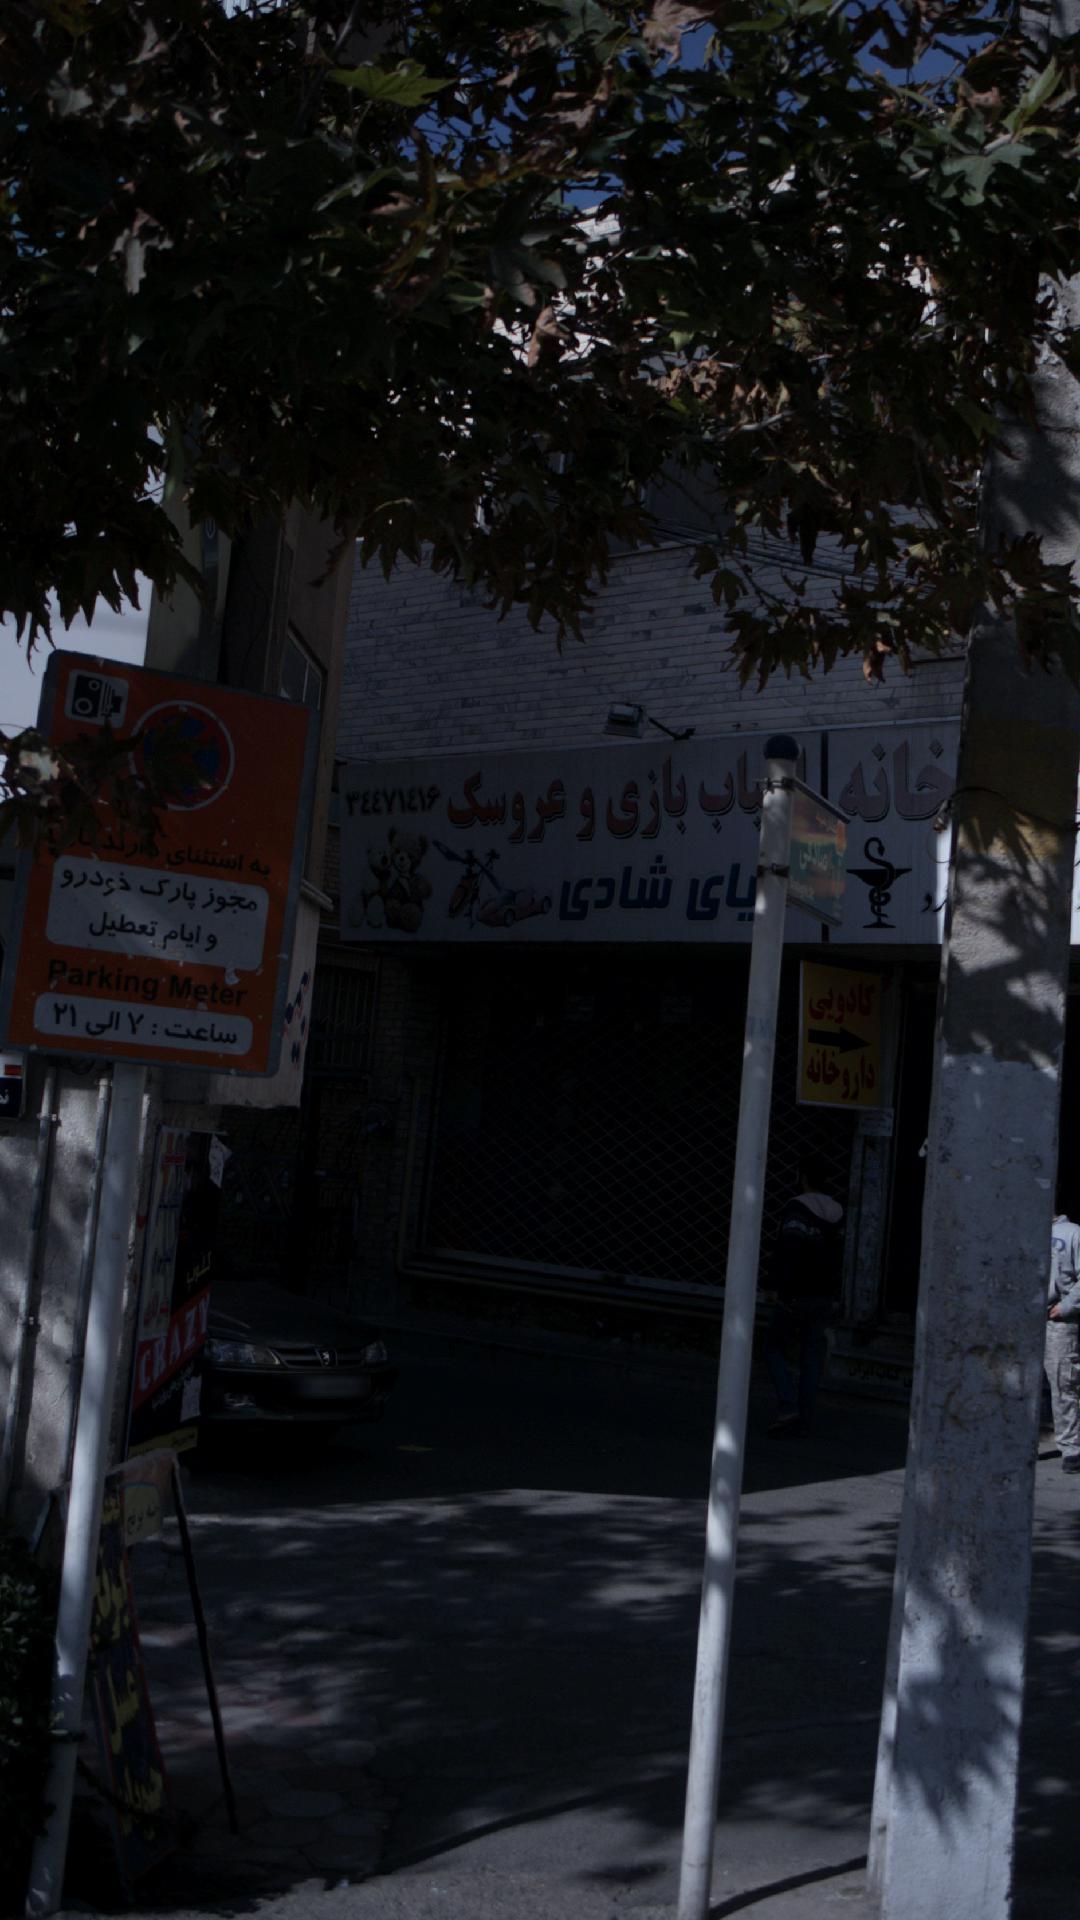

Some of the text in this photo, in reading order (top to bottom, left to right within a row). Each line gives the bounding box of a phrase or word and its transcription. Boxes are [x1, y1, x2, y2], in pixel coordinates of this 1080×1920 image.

[447, 771, 566, 843] عروسک
[576, 786, 594, 841] و
[606, 754, 687, 839] بازی
[166, 844, 243, 872] استثنای
[248, 853, 271, 877] به
[139, 878, 196, 909] پارک
[202, 887, 258, 913] مجوز
[559, 854, 673, 921] شادی
[89, 911, 218, 952] و ایام تعطیل
[48, 958, 248, 1008] Parking Meter
[53, 1002, 77, 1026] ۲۱
[85, 1009, 120, 1036] الی
[128, 1012, 145, 1036] ۷
[806, 1050, 875, 1100] داروخانه
[138, 1295, 212, 1393] CRAZY
